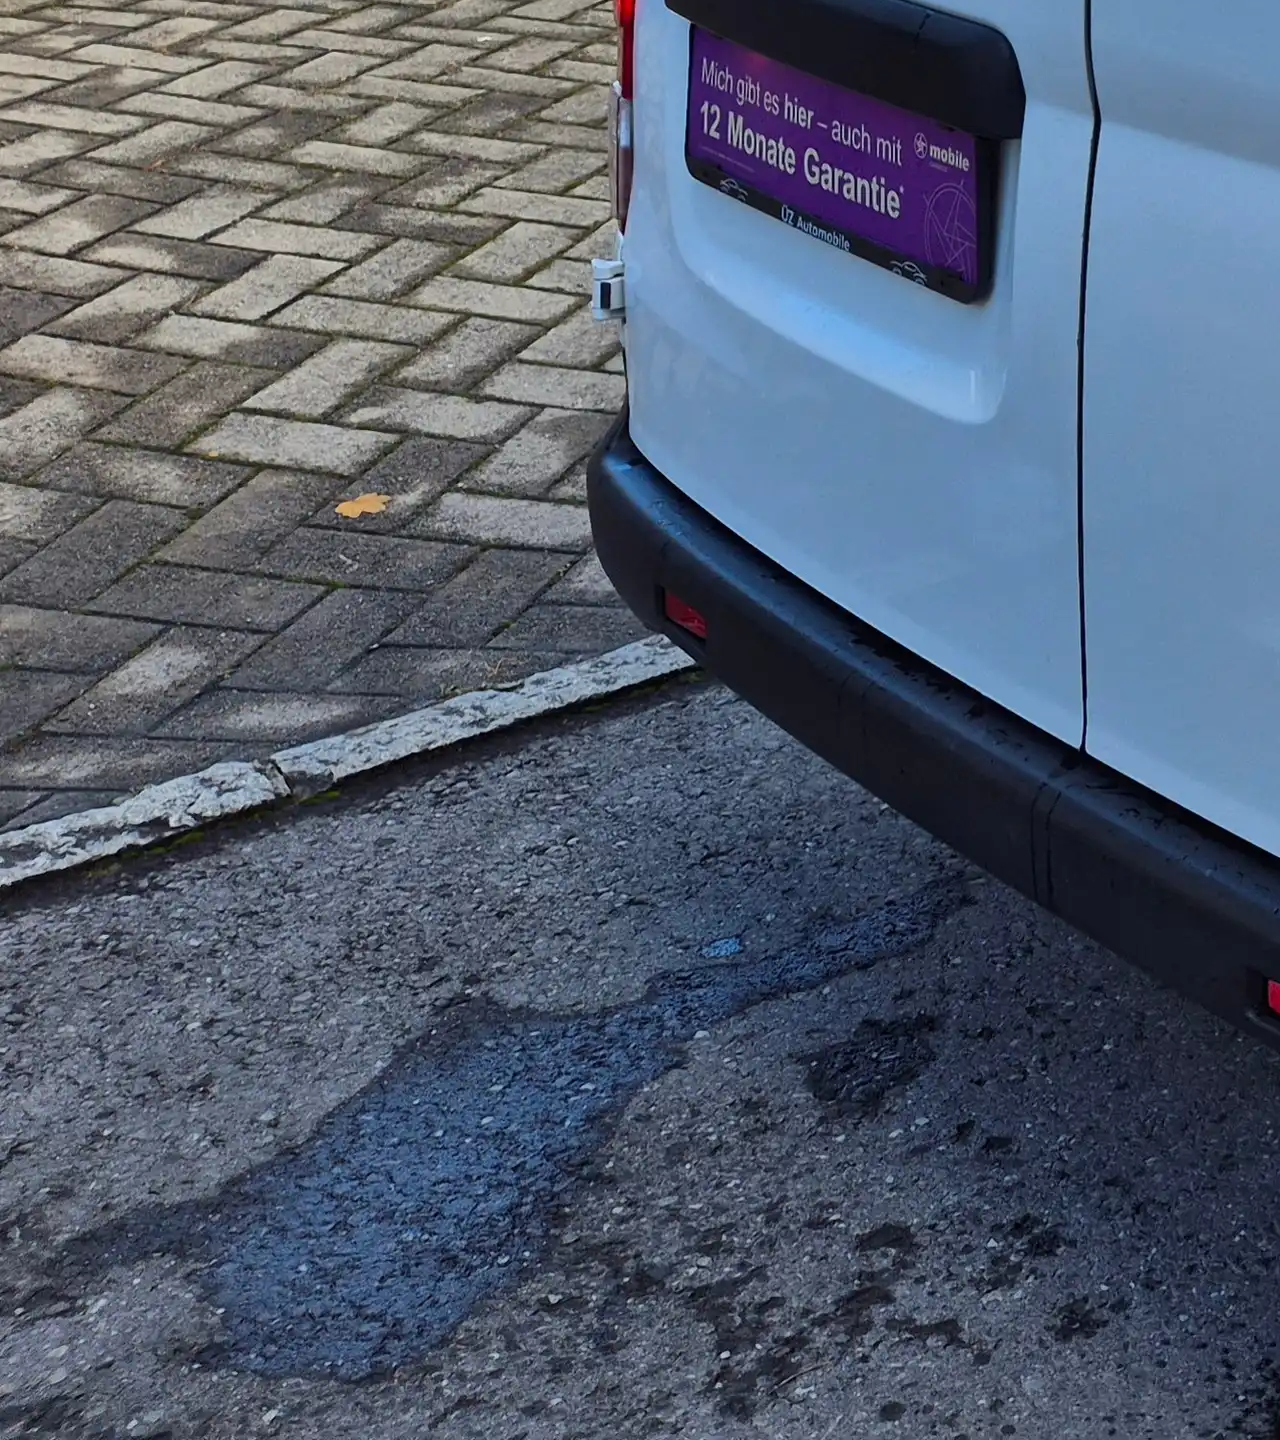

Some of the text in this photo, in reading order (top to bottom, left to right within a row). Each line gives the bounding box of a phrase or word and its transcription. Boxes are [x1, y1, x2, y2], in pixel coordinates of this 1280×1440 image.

[700, 100, 720, 140] 12
[727, 110, 797, 176] Monate
[701, 57, 733, 95] Mich
[736, 76, 761, 108] gibt
[763, 90, 780, 116] es
[784, 93, 815, 130] hier
[831, 119, 872, 155] auch
[876, 135, 902, 167] mit
[929, 144, 970, 172] mobile
[781, 204, 851, 252] ÜZ Automobile
